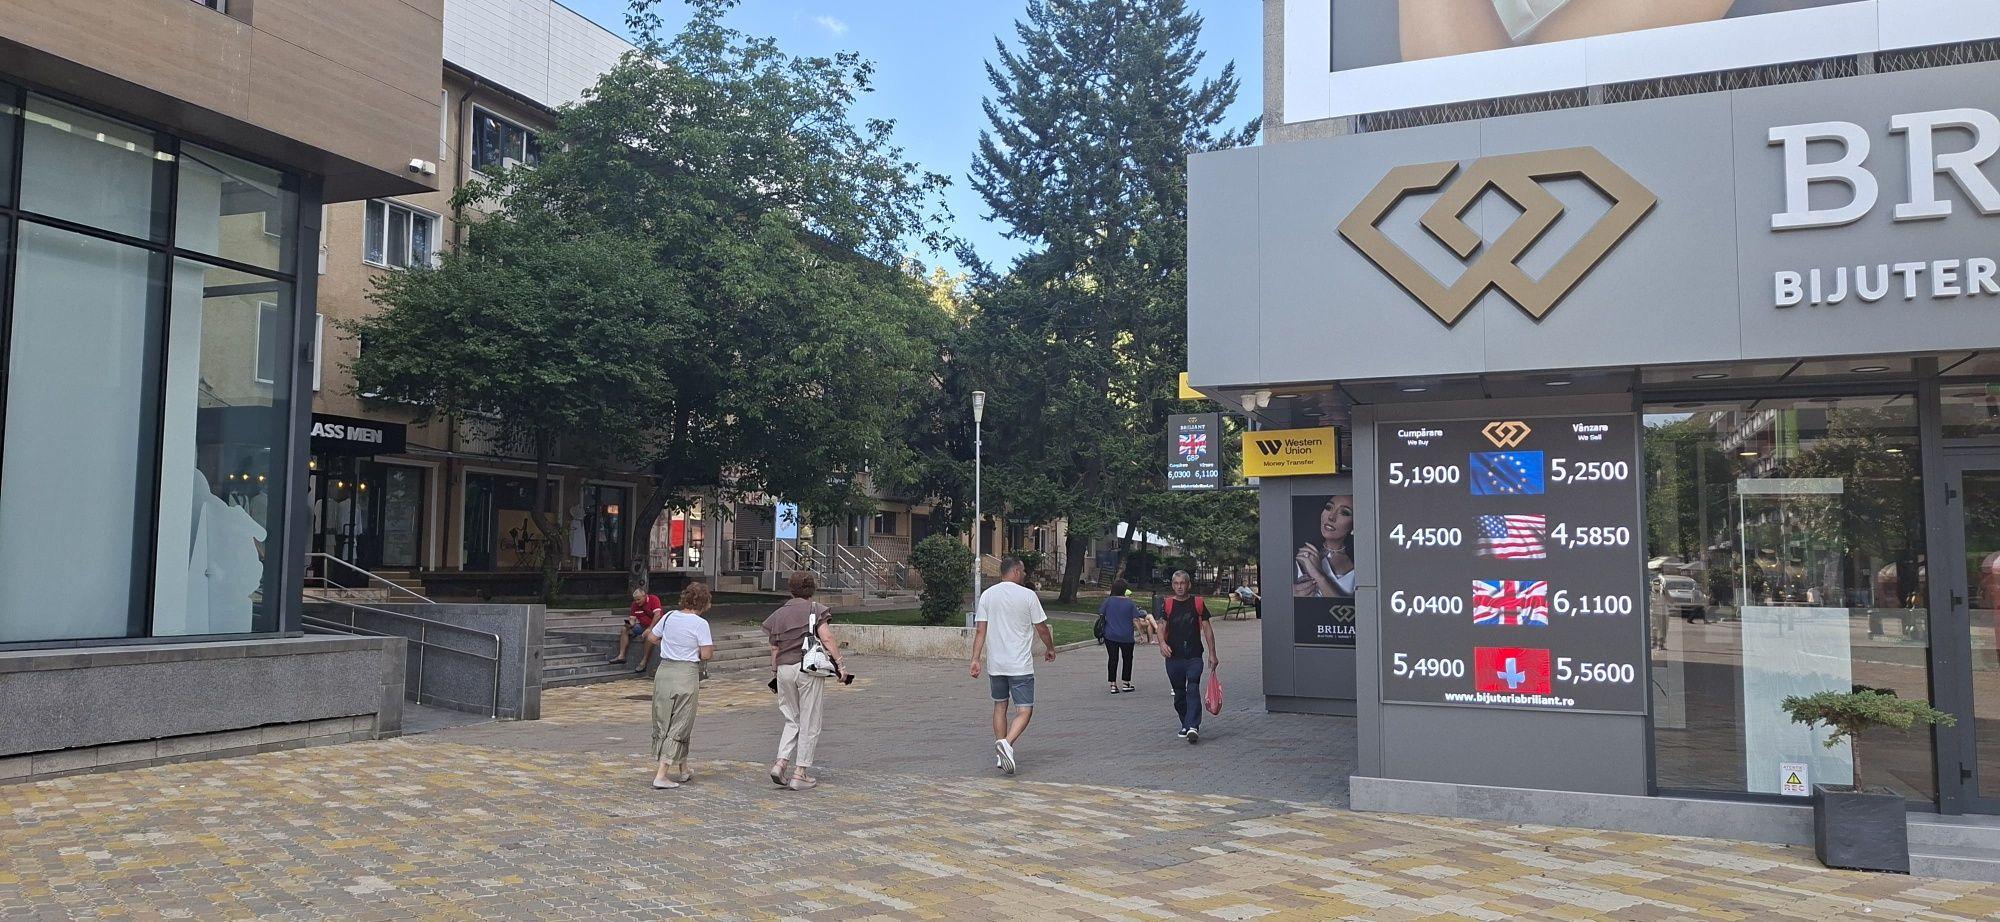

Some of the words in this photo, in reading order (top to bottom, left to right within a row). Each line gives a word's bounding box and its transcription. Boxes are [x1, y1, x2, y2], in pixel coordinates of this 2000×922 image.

[1768, 108, 2000, 231] BR
[1775, 257, 2000, 308] BIJUTER
[310, 422, 345, 439] ASS
[347, 426, 383, 443] MEN
[1285, 438, 1322, 447] Western
[1186, 454, 1200, 462] GBP
[1285, 446, 1312, 455] Union
[1195, 469, 1219, 479] 6,1100
[1389, 462, 1460, 487] 5,1900
[1551, 458, 1628, 484] 5,2500
[1389, 523, 1462, 549] 4,4500
[1551, 522, 1630, 548] 4,5850
[1390, 590, 1463, 616] 6,0400
[1553, 589, 1632, 617] 6,1100
[1393, 653, 1465, 679] 5,4900
[1556, 658, 1635, 684] 5,5600
